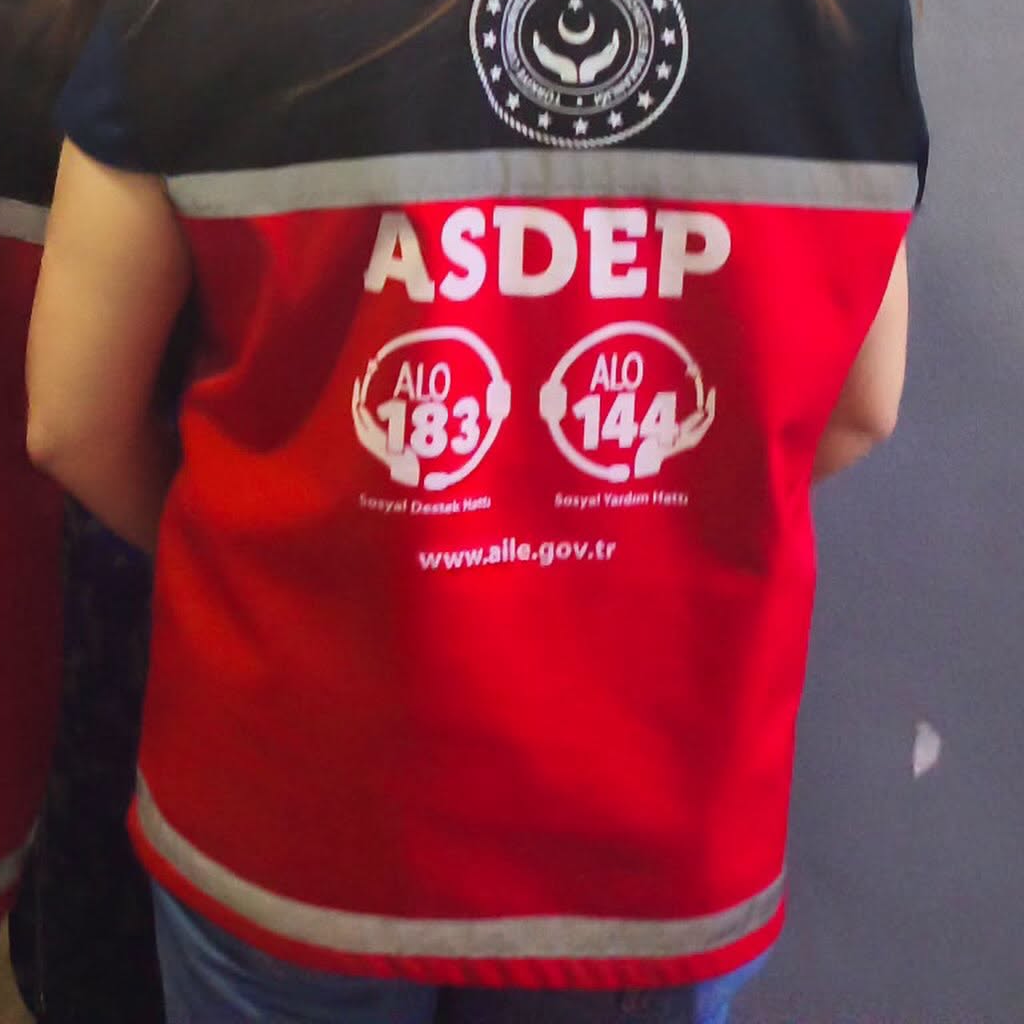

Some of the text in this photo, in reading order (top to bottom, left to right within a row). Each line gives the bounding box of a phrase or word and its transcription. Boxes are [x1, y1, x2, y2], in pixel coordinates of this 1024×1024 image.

[363, 205, 732, 303] ASDEP
[393, 360, 451, 403] ALO
[590, 351, 644, 392] ALO
[376, 395, 481, 459] 183
[572, 391, 677, 451] 144
